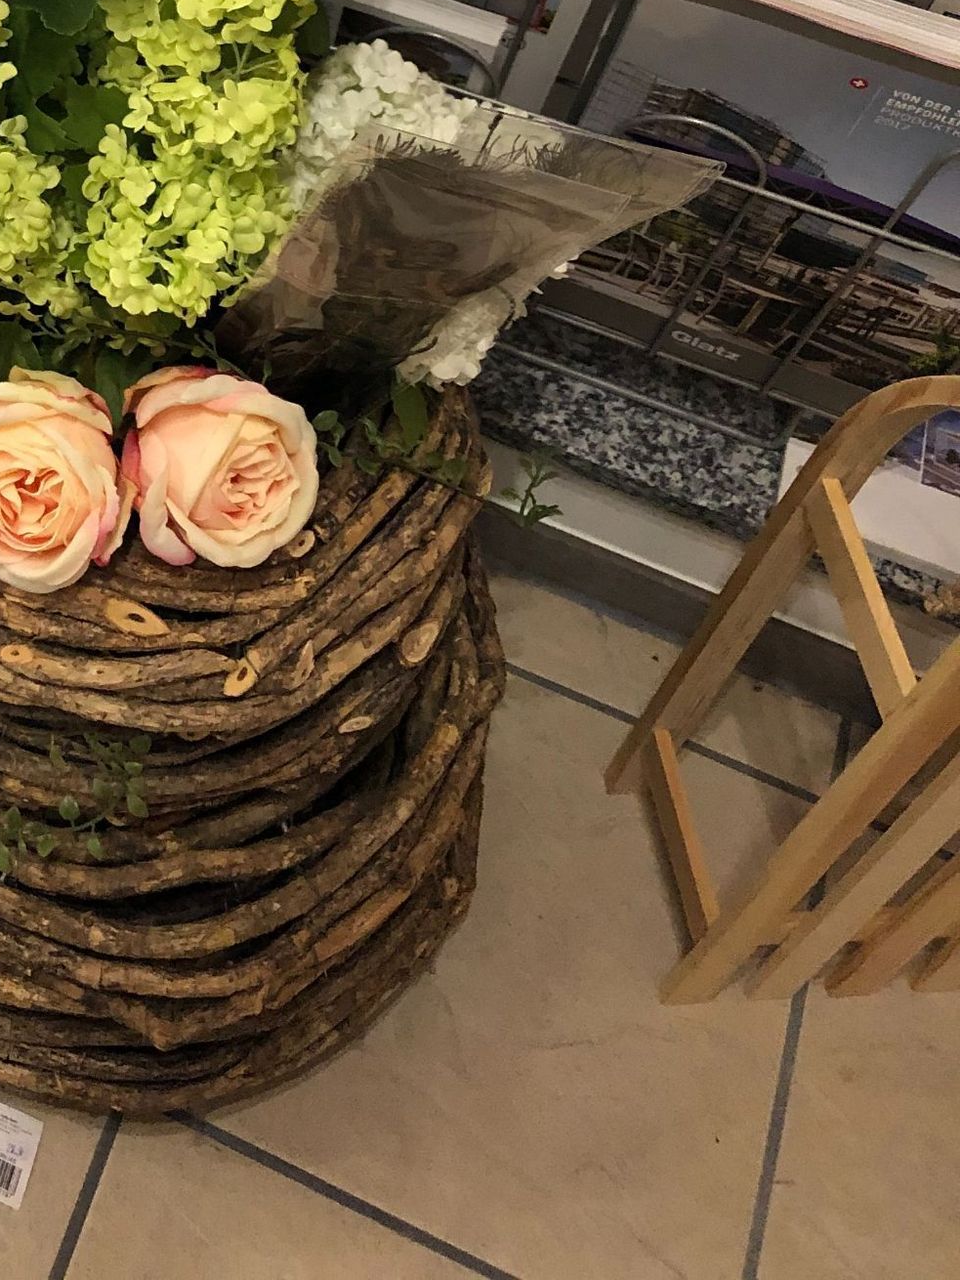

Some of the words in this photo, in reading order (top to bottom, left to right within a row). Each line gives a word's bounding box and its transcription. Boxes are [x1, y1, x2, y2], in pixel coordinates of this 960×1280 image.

[893, 89, 921, 104] VON
[924, 99, 952, 113] DER
[671, 330, 740, 362] Glatz
